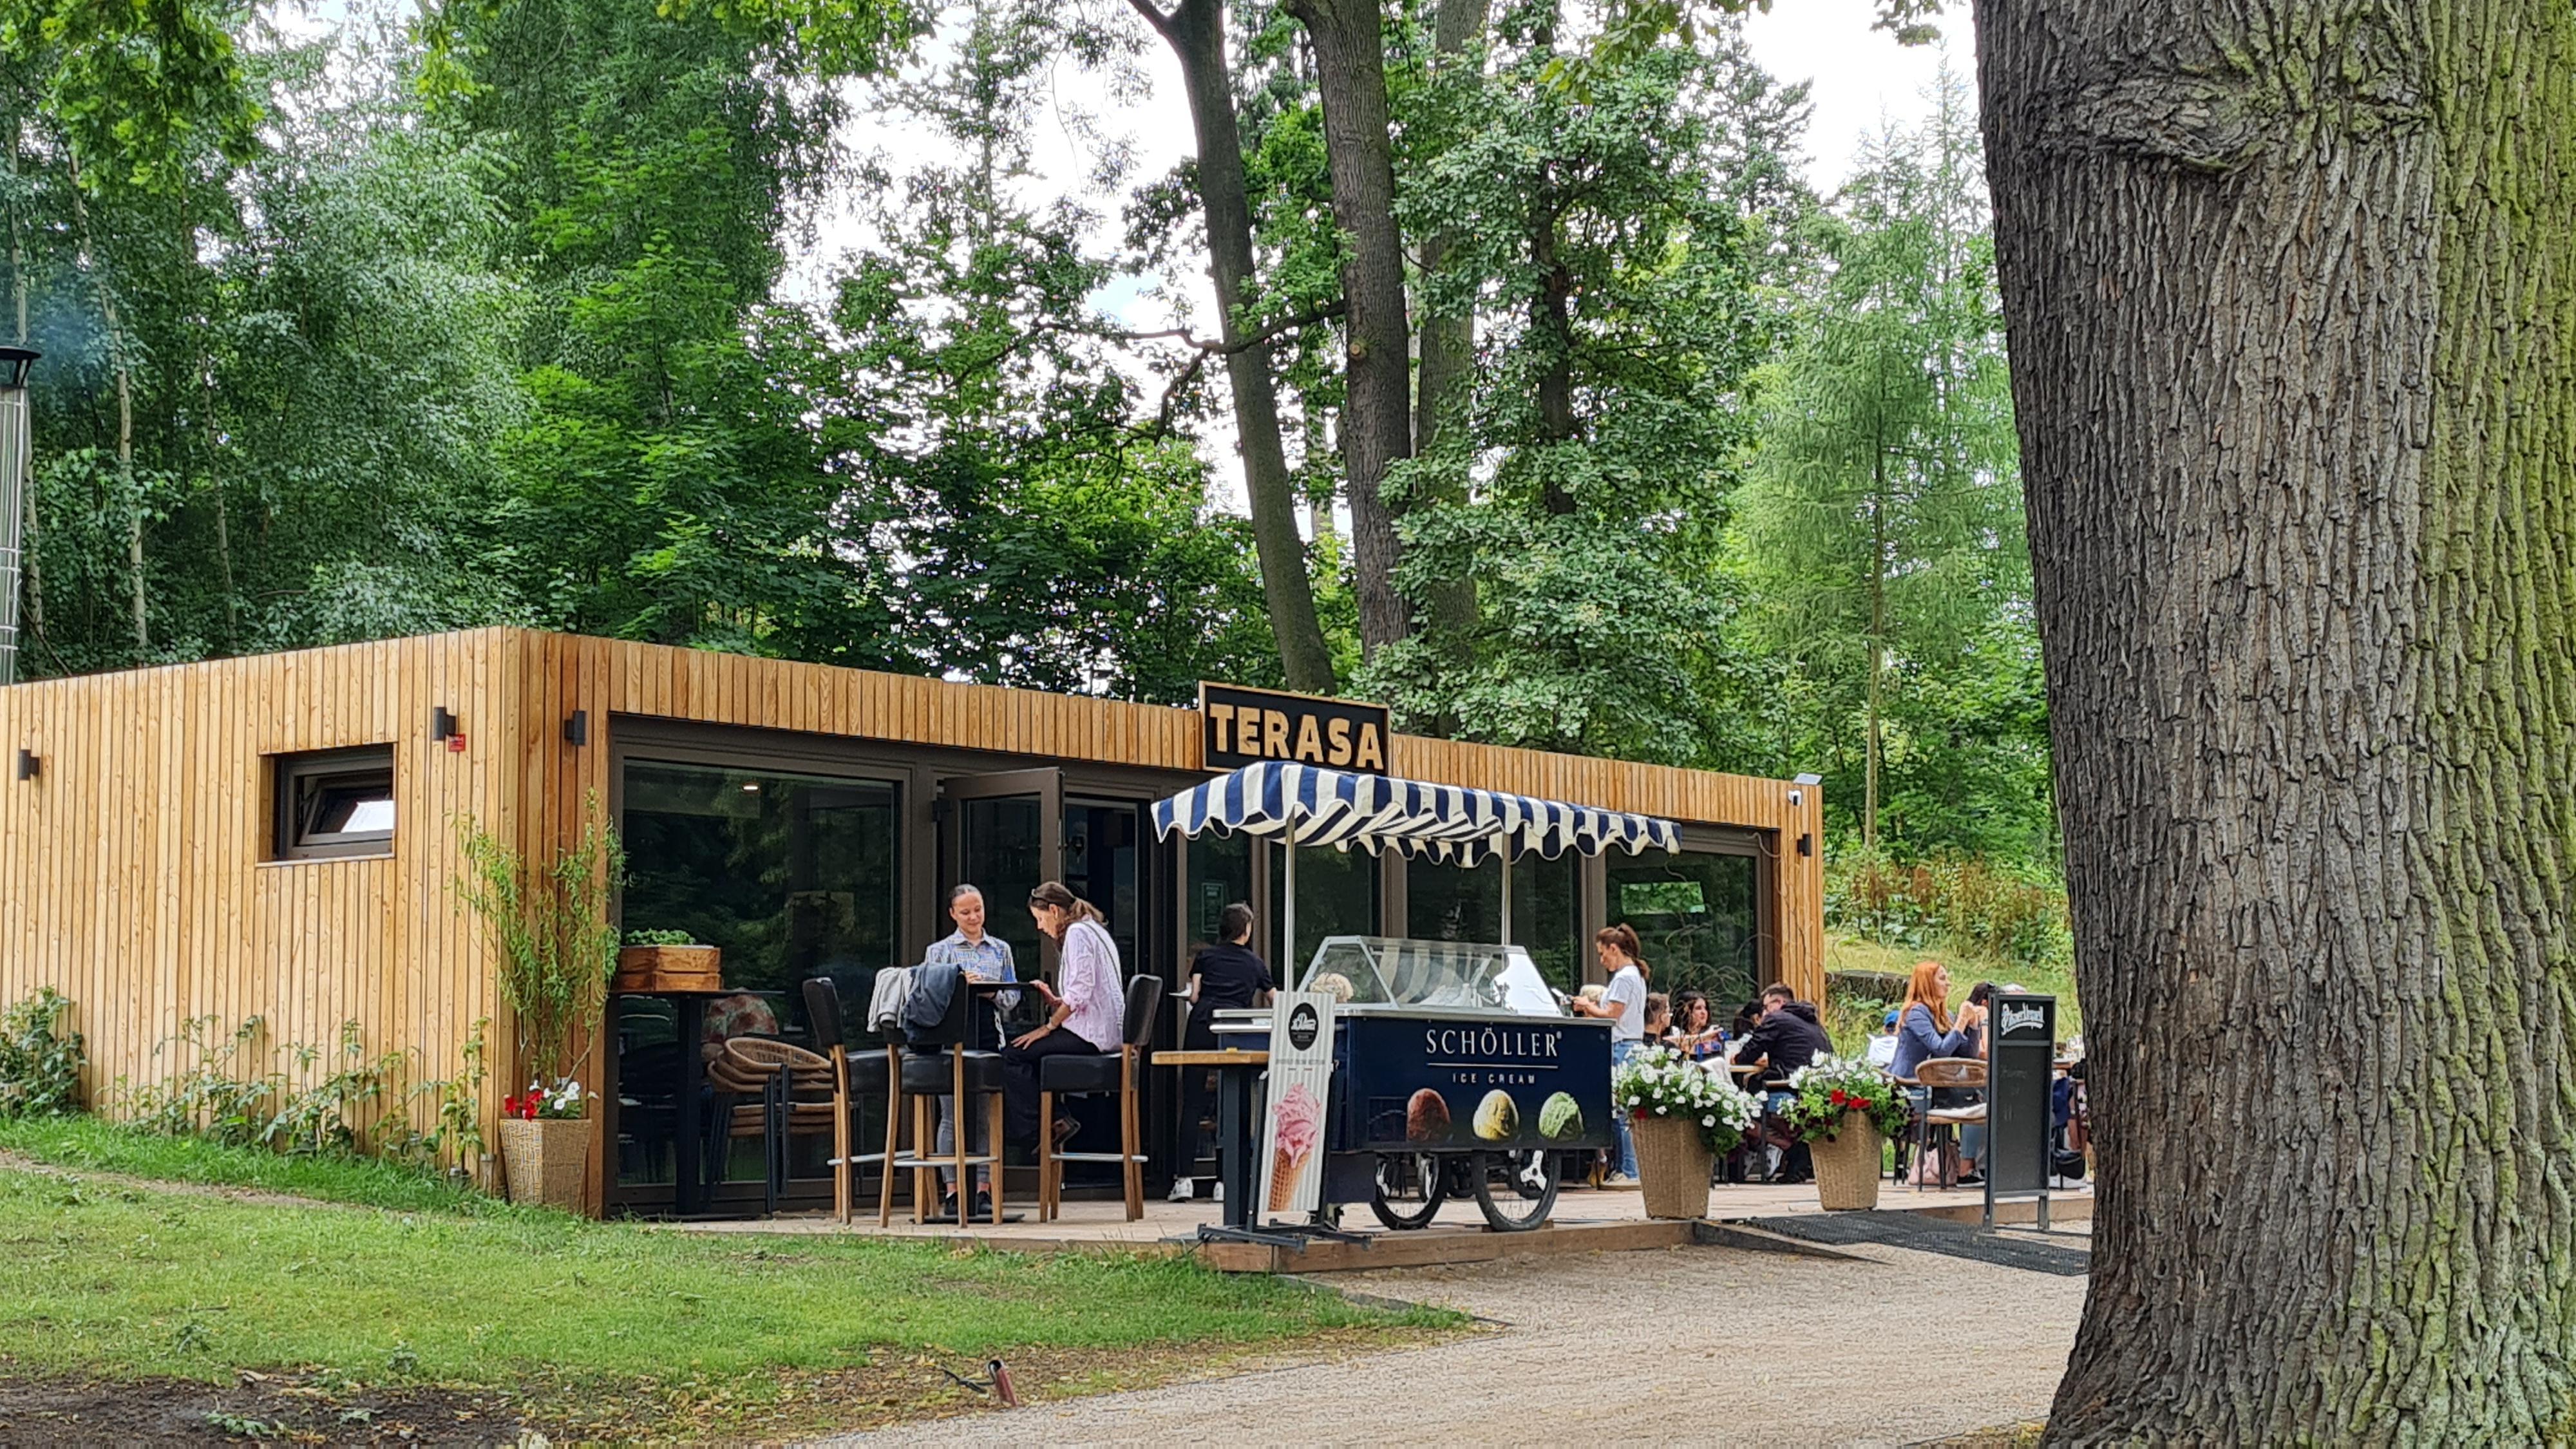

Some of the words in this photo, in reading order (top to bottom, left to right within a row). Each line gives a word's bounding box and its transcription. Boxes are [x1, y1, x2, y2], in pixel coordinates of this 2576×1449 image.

[1209, 703, 1384, 770] TERASA
[1452, 1073, 1477, 1083] ICE
[1488, 1073, 1535, 1084] CREAM
